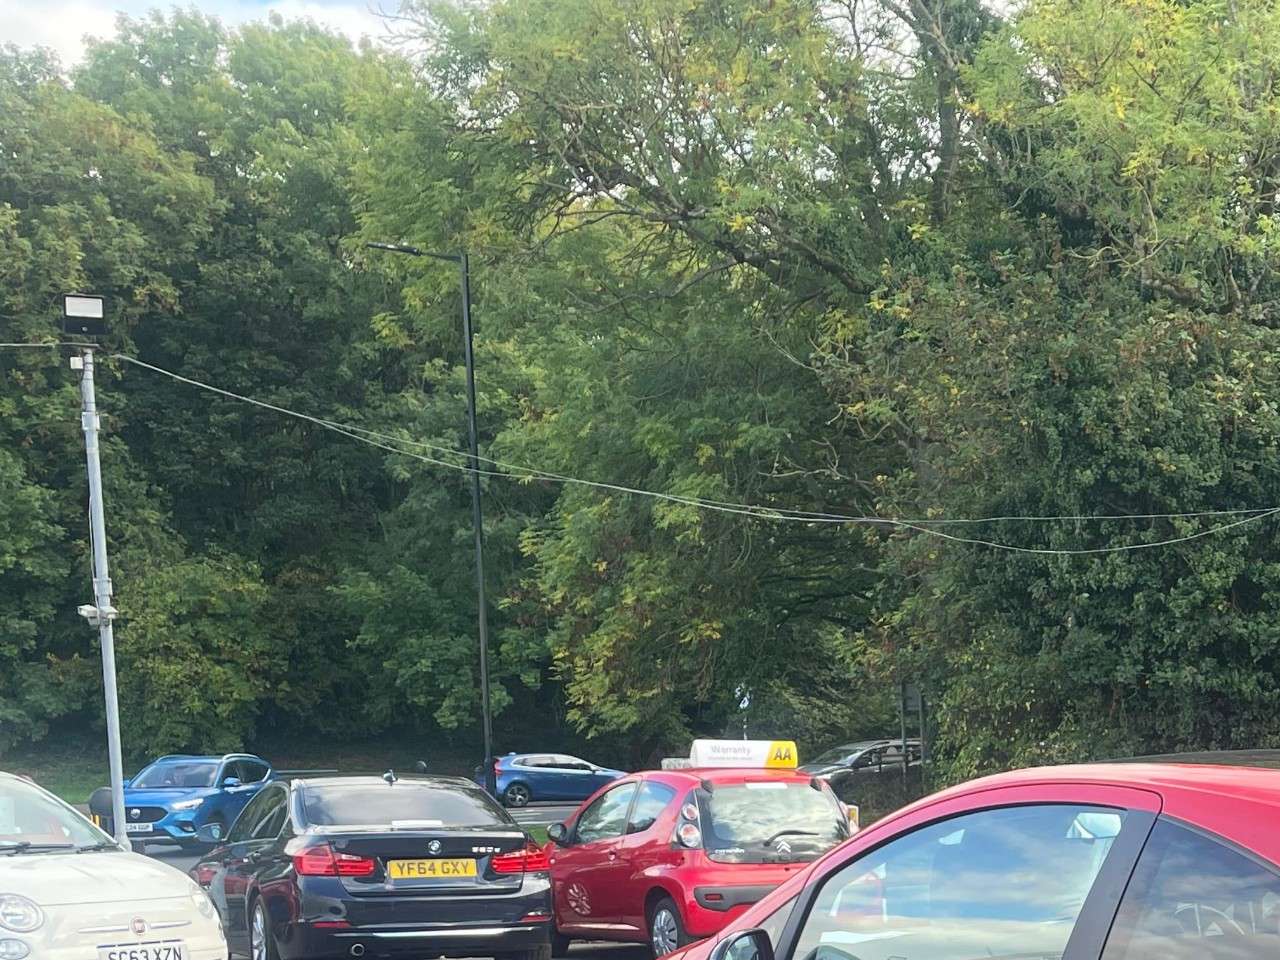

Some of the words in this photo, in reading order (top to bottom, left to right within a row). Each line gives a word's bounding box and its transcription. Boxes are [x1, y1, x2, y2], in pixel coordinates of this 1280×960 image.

[711, 744, 751, 756] Warranty
[773, 749, 792, 761] AA
[396, 862, 436, 876] YF64
[440, 861, 470, 875] GXY
